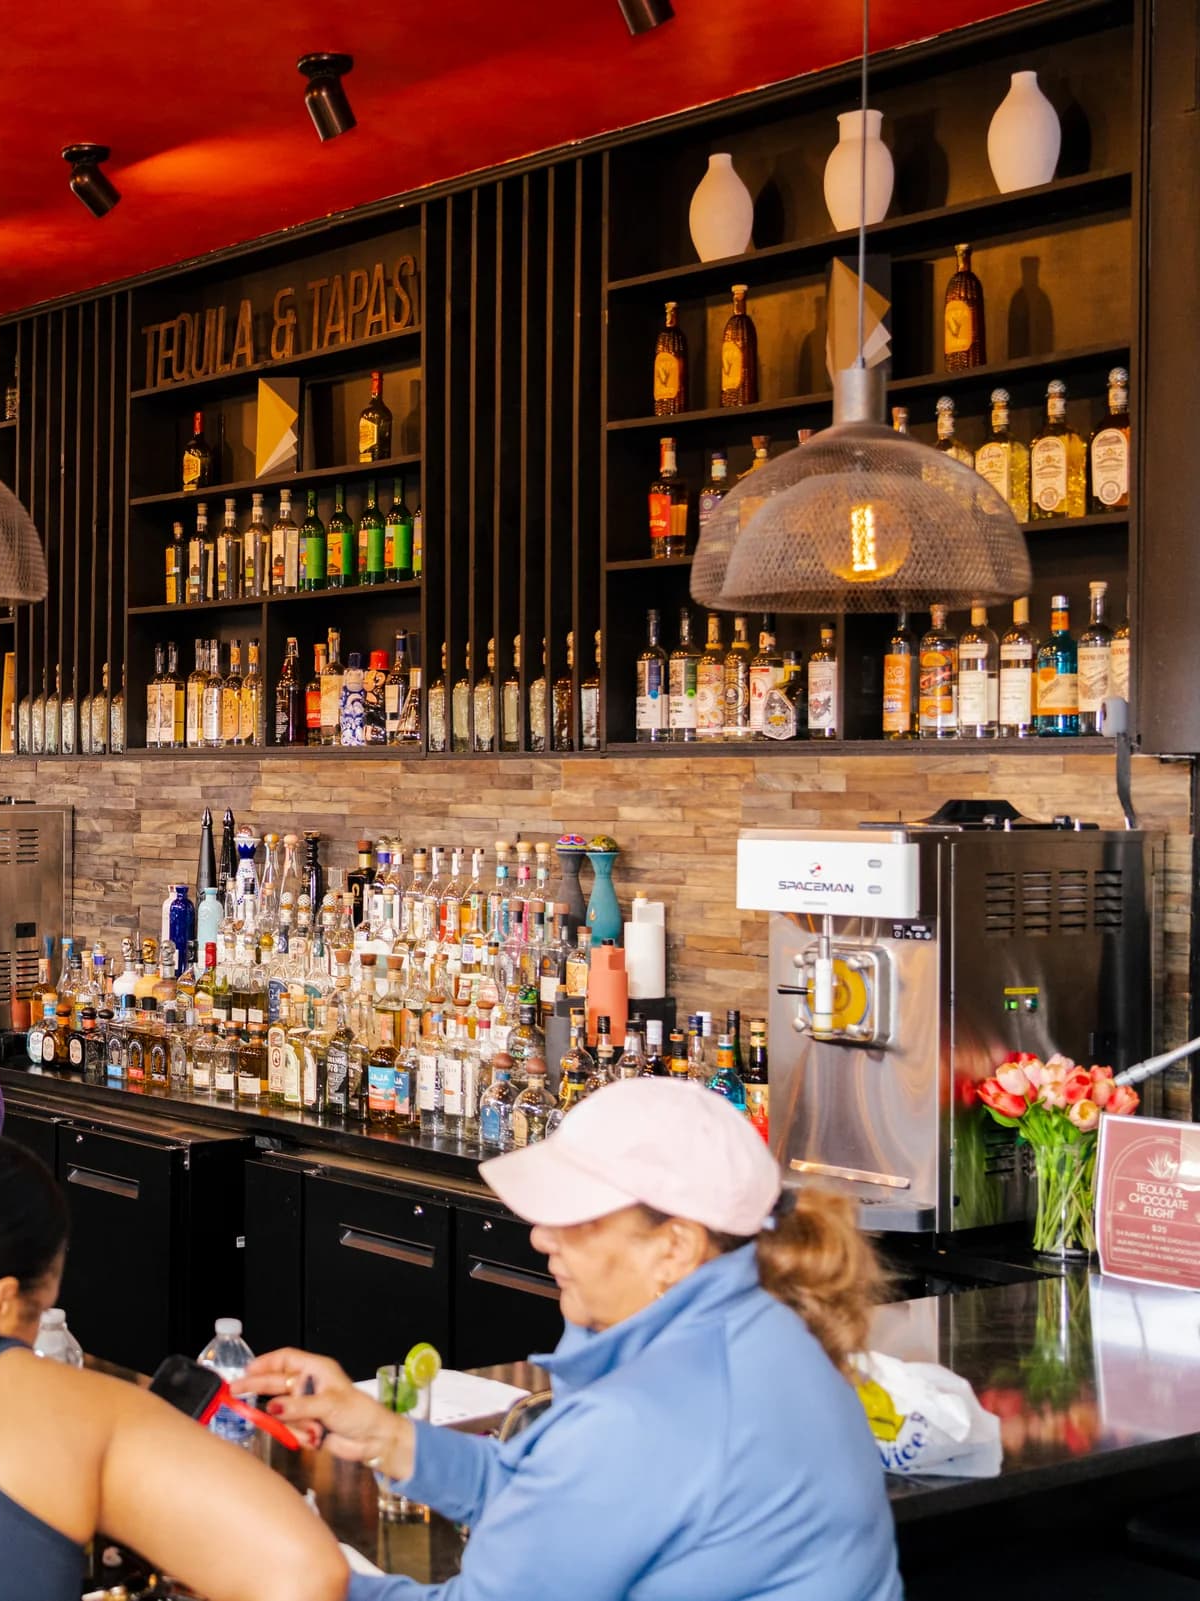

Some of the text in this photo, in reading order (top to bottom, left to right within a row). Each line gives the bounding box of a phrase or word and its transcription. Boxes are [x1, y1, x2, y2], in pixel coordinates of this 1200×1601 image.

[141, 255, 416, 389] TEQUILA & TAPAS
[778, 880, 854, 893] SPACEMAN
[1136, 1183, 1184, 1198] TEQUILA &
[1128, 1193, 1189, 1211] CHOCOLATE
[1143, 1206, 1175, 1219] FLIGHT
